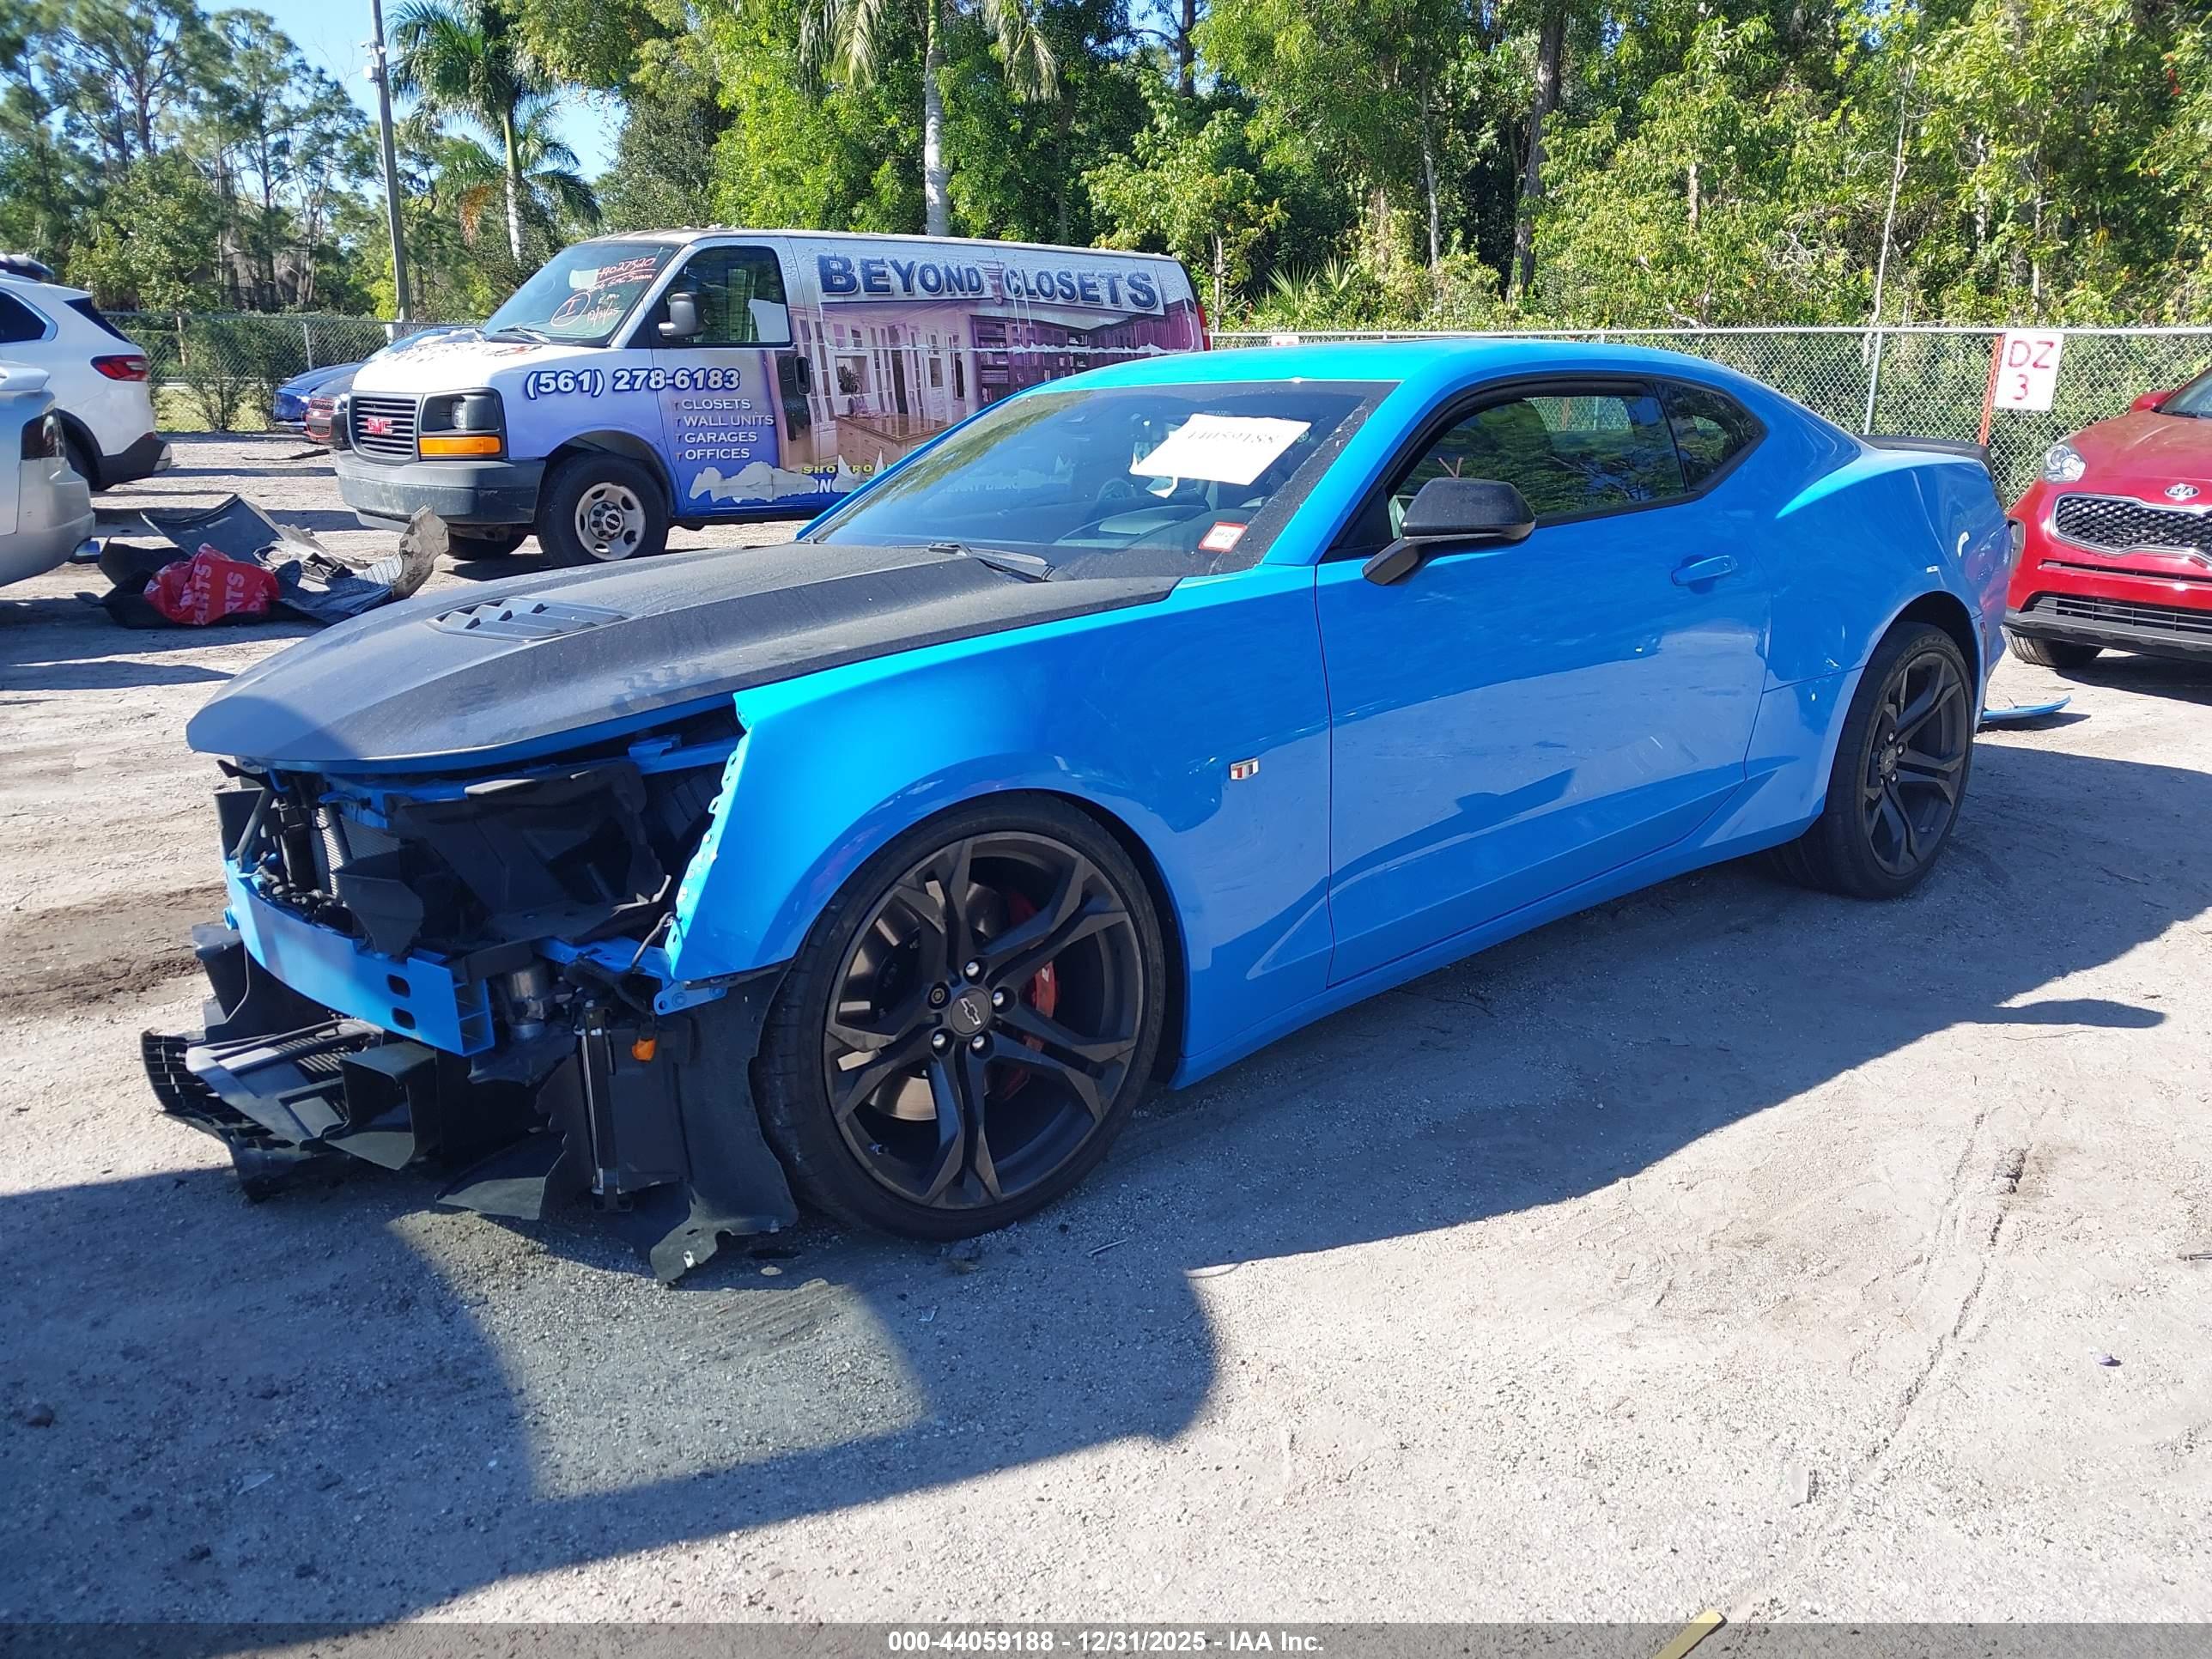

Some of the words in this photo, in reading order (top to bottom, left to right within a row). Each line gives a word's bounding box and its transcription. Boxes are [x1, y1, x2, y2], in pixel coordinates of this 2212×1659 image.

[817, 254, 985, 295] BEYOND
[1006, 267, 1160, 311] CLOSETS
[2008, 340, 2054, 368] DZ
[525, 369, 605, 399] (561)
[611, 367, 741, 392] 278-6183
[2013, 373, 2029, 400] 3
[681, 398, 752, 410] CLOSETS
[368, 417, 392, 435] GMC
[684, 416, 729, 428] WALL
[730, 414, 775, 426] UNITS
[684, 432, 758, 444] GARAGES
[684, 448, 750, 460] OFFICES
